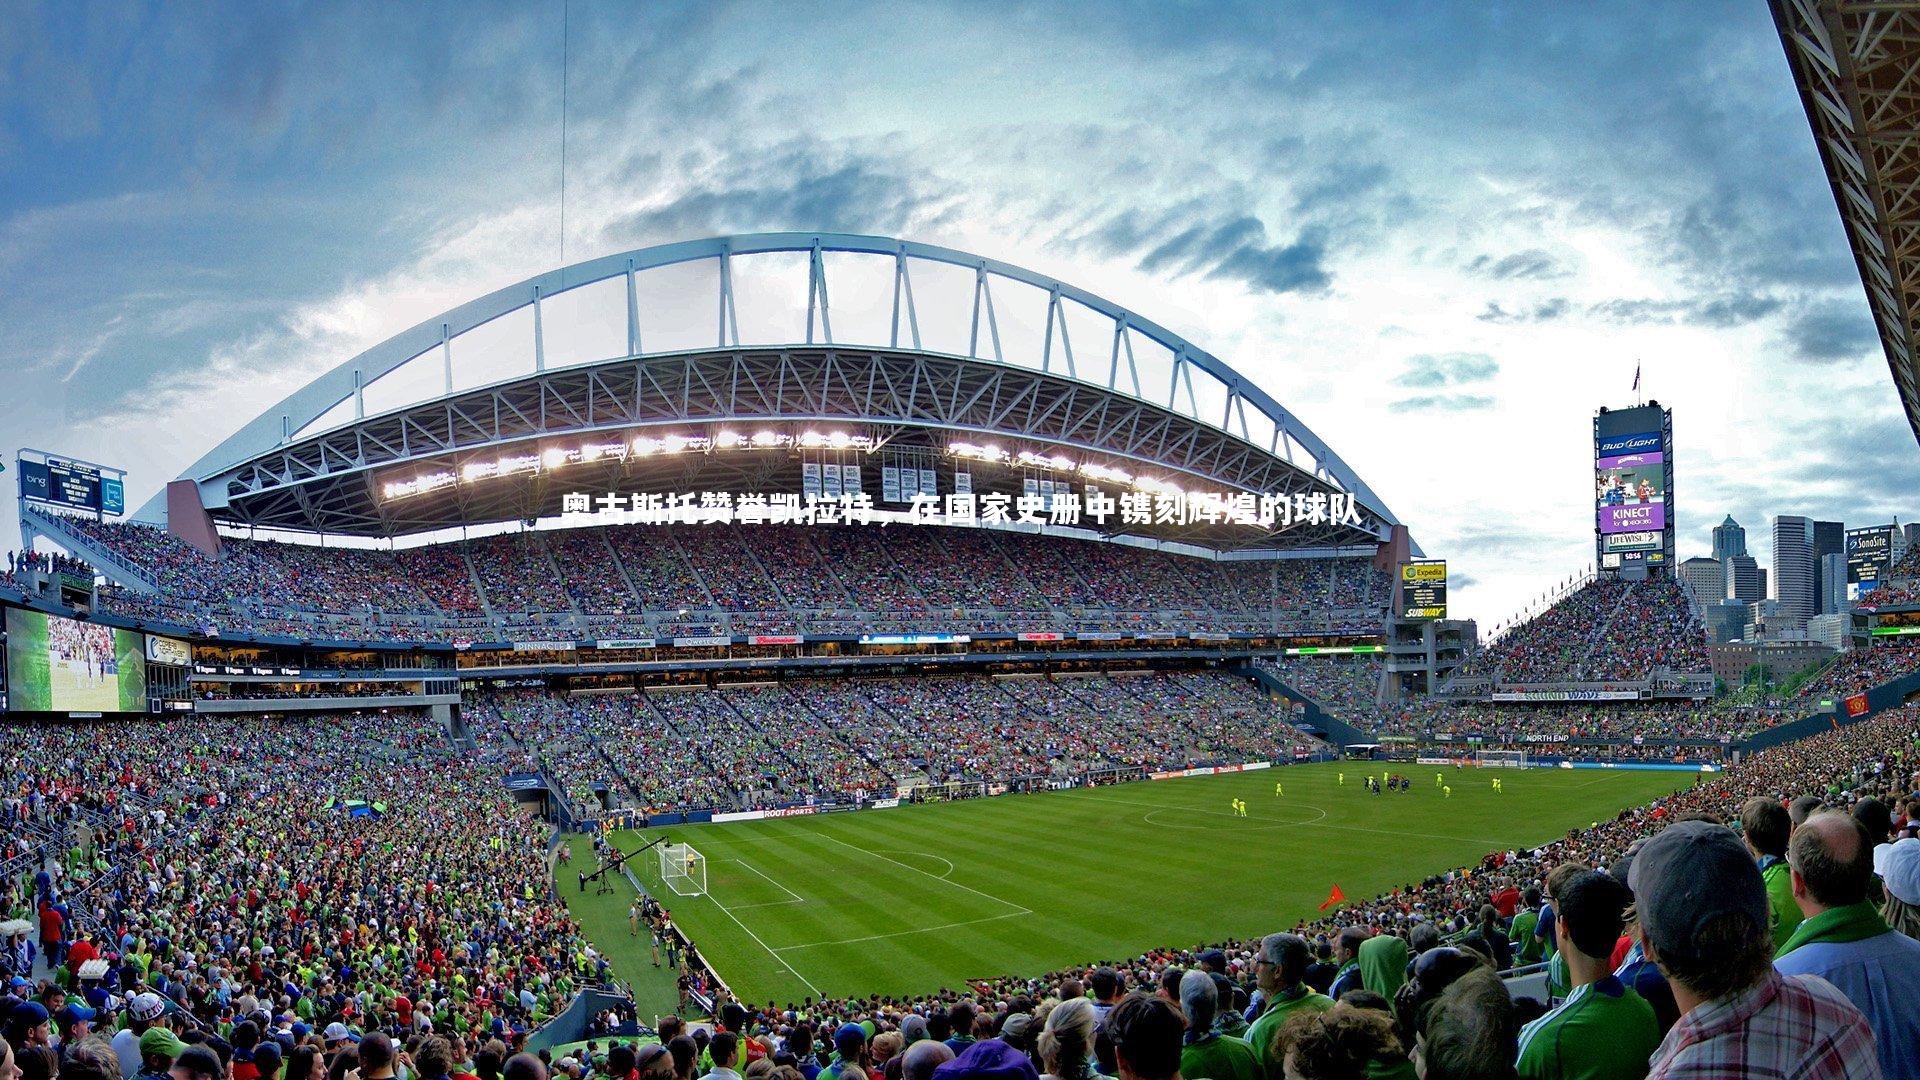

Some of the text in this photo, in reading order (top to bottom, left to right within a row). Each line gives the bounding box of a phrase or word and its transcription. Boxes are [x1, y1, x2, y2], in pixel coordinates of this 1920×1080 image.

[1602, 438, 1659, 450] BUD LIGHT
[26, 474, 46, 487] bing
[1613, 506, 1653, 519] KINECT
[1857, 535, 1886, 549] SonoSite
[1416, 569, 1442, 577] Expedia
[1405, 607, 1445, 618] SUBWAY
[518, 642, 564, 651] PINNACLE
[685, 638, 711, 647] Qwest
[1526, 733, 1570, 743] NORTH END
[764, 808, 786, 818] ROOT
